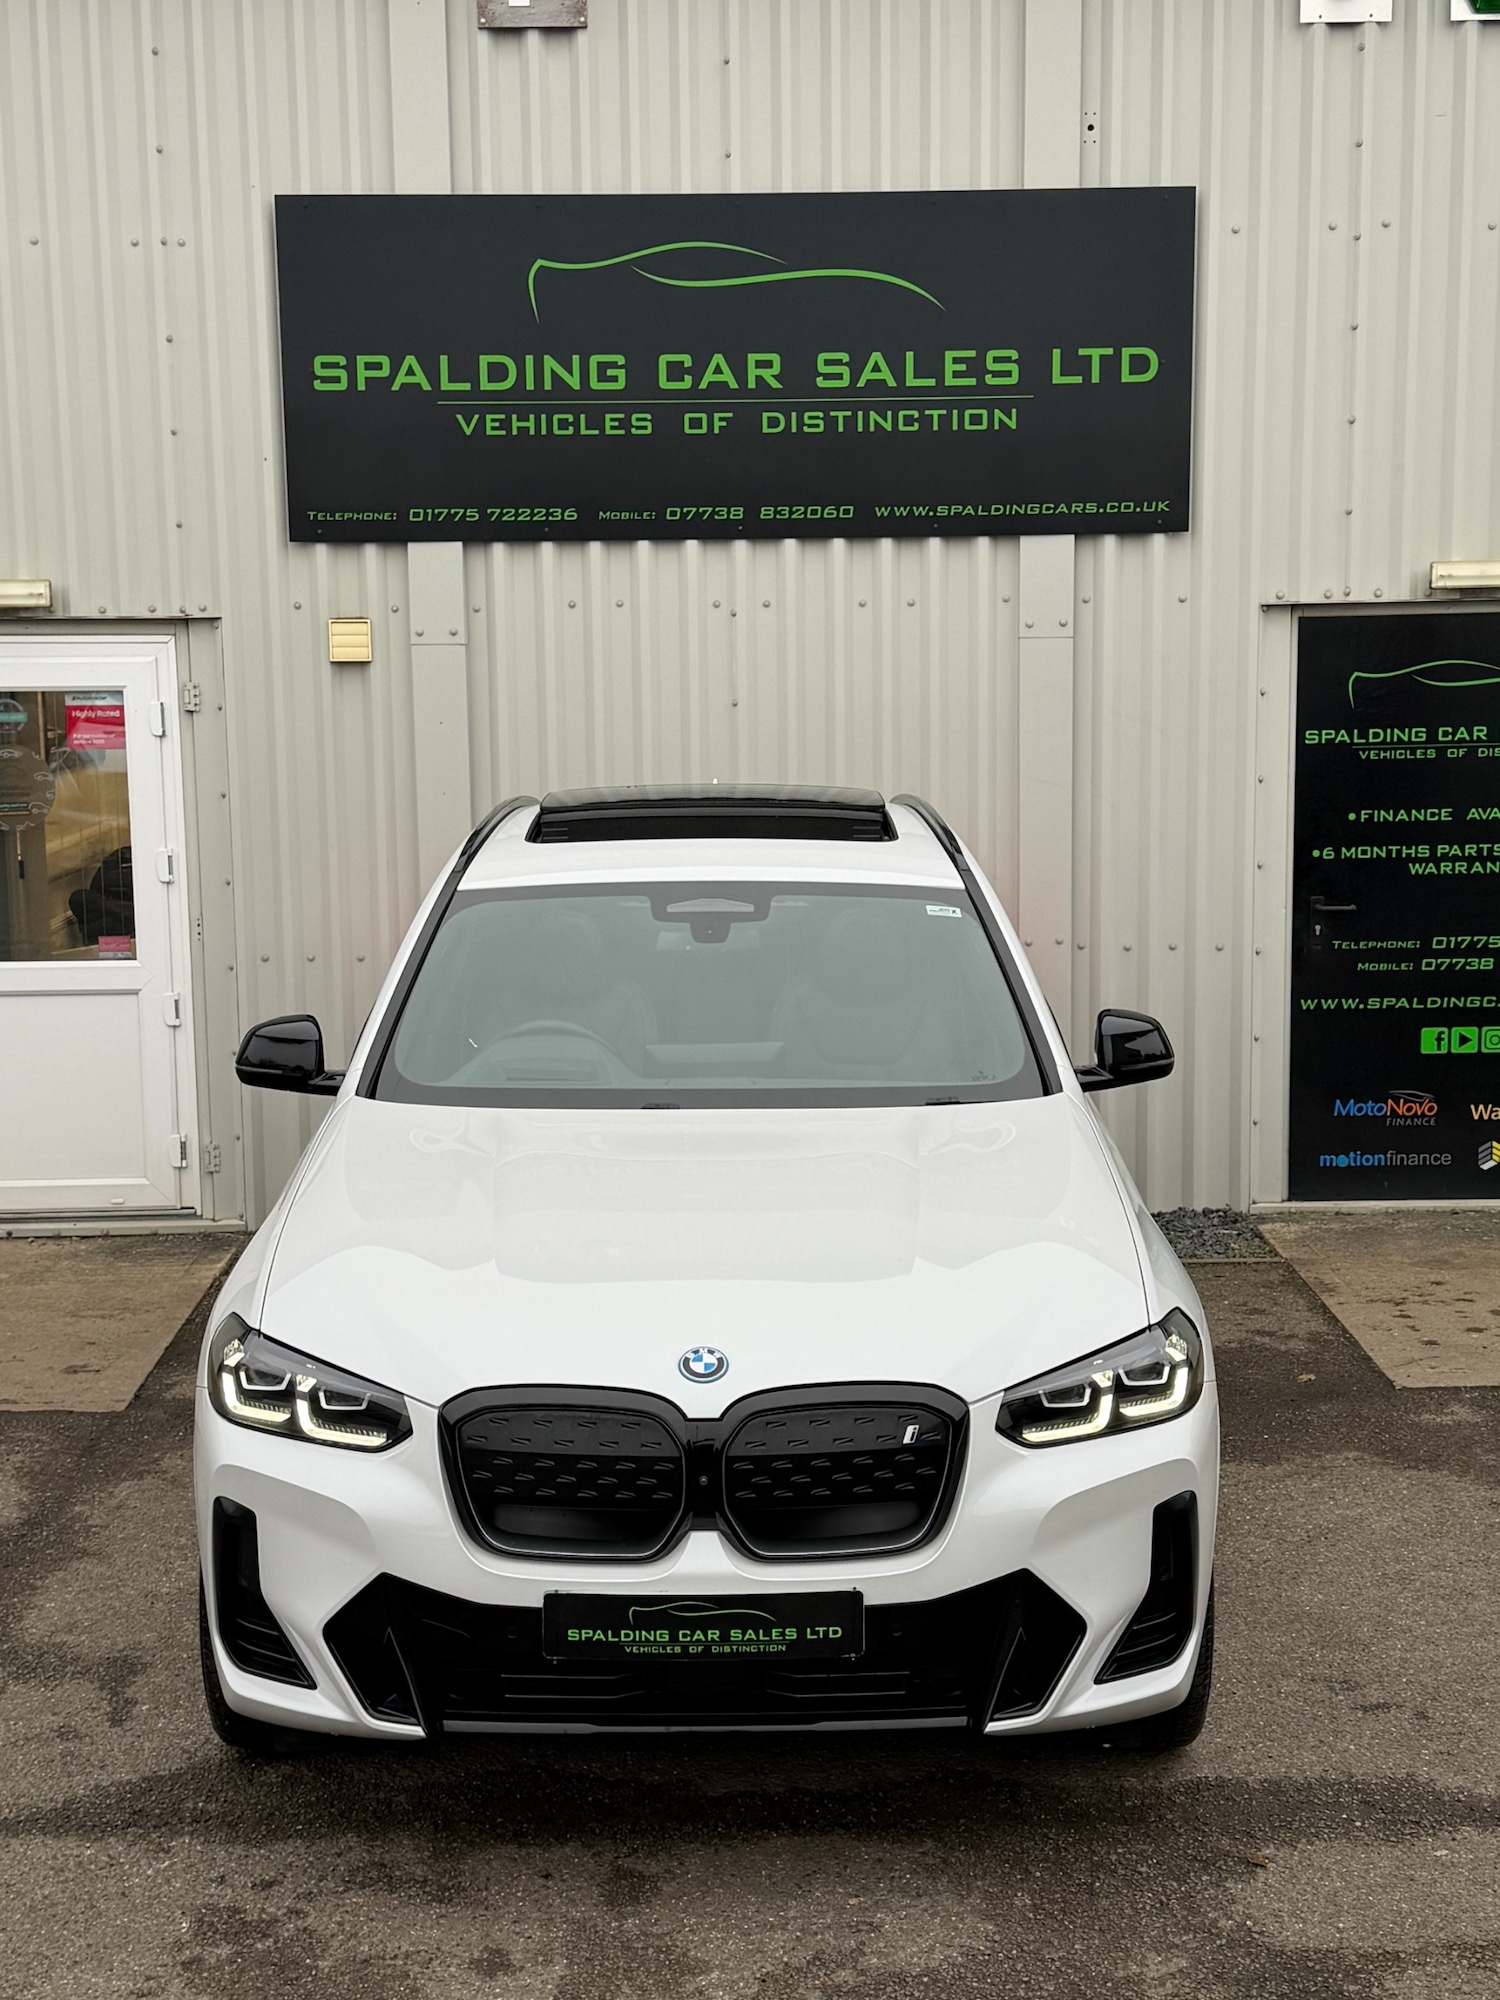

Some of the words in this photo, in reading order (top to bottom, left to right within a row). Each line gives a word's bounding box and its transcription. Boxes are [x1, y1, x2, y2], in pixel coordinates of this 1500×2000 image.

[312, 353, 627, 392] SPALDING
[657, 351, 784, 391] CAR
[815, 348, 1020, 389] SALES
[1051, 345, 1160, 385] LTD
[455, 412, 653, 437] VEHICLES
[683, 411, 734, 436] OF
[761, 407, 1018, 434] DISTINCTION
[408, 508, 480, 522] 01775
[486, 507, 578, 521] 722236
[665, 506, 745, 520] 07738
[759, 505, 855, 519] 832060
[71, 710, 96, 719] Highly
[96, 709, 121, 718] Rated
[1304, 727, 1427, 745] SPALDING
[1437, 725, 1488, 742] CAR
[1359, 749, 1436, 760] VEHICLES
[1446, 747, 1468, 758] OF
[1360, 808, 1453, 823] FINANCE
[1322, 847, 1335, 860] 6
[1341, 845, 1430, 859] MONTHS
[1408, 861, 1500, 876] WARRAN
[1431, 935, 1500, 950] 01775
[1421, 957, 1495, 971] 07738
[1300, 996, 1500, 1011] WWW.SPALDINGC
[1333, 1098, 1439, 1117] MotoNovo
[1386, 1117, 1437, 1127] FINANCE
[567, 1629, 670, 1642] SPALDING
[678, 1629, 720, 1641] CAR
[729, 1627, 798, 1640] SALES
[806, 1626, 843, 1639] LTD
[624, 1645, 681, 1654] VEHICLES
[689, 1645, 704, 1653] OF
[711, 1644, 787, 1653] DISTINCTION
